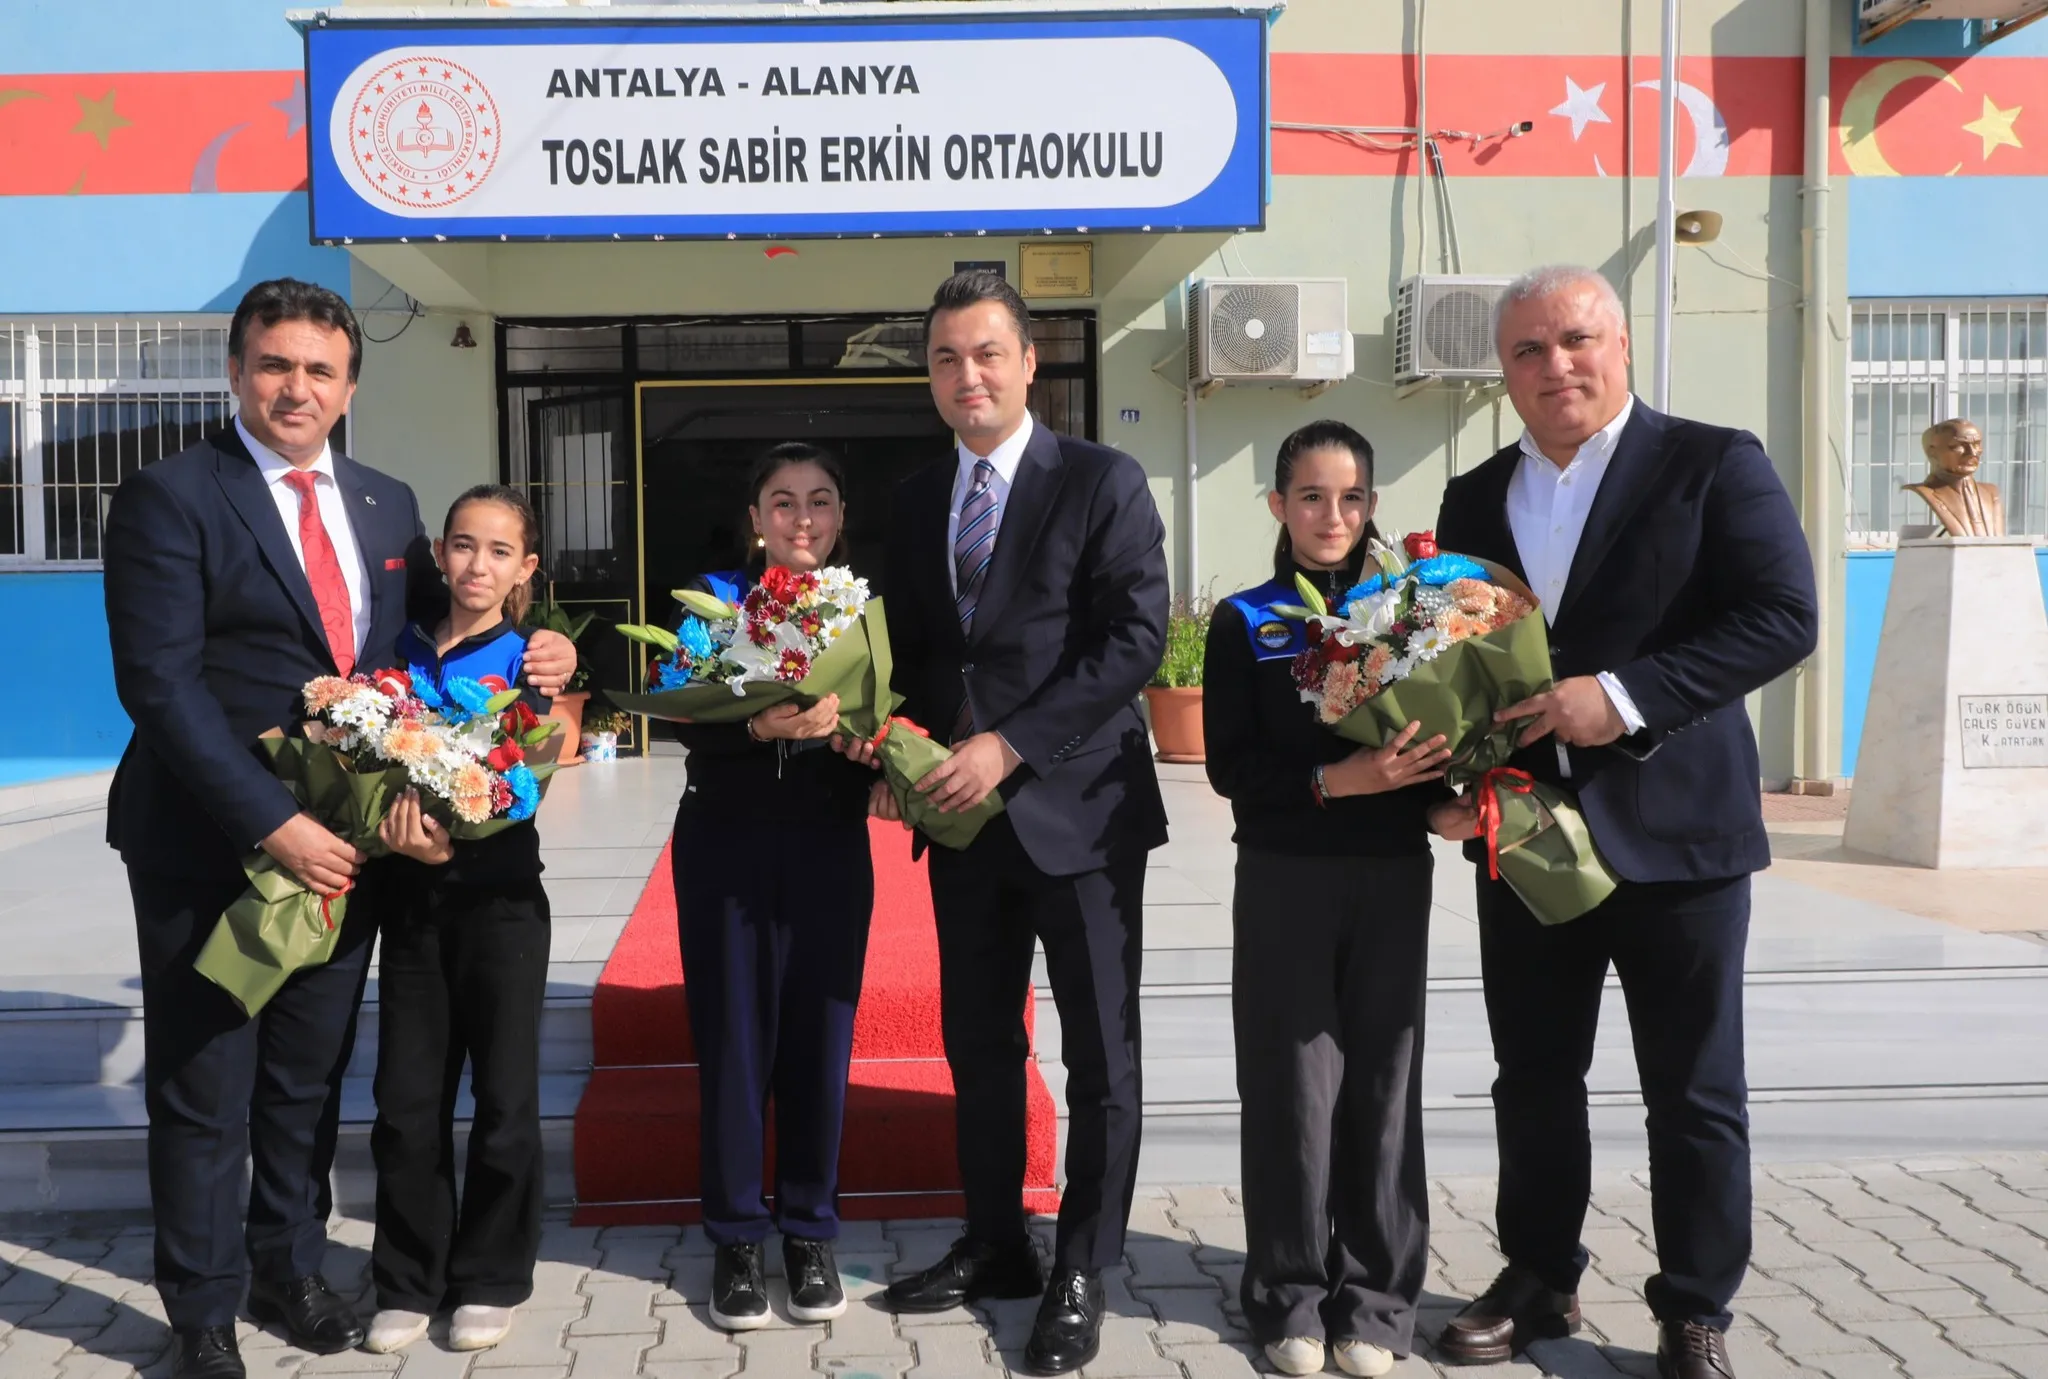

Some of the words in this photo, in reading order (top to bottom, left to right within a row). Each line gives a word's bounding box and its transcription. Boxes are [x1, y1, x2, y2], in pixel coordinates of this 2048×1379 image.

[546, 67, 726, 98] ANTALYA
[761, 65, 920, 96] ALANYA
[542, 138, 688, 185] TOSLAK
[699, 125, 809, 184] SABİR
[820, 123, 931, 182] ERKİN
[944, 131, 1163, 181] ORTAOKULU
